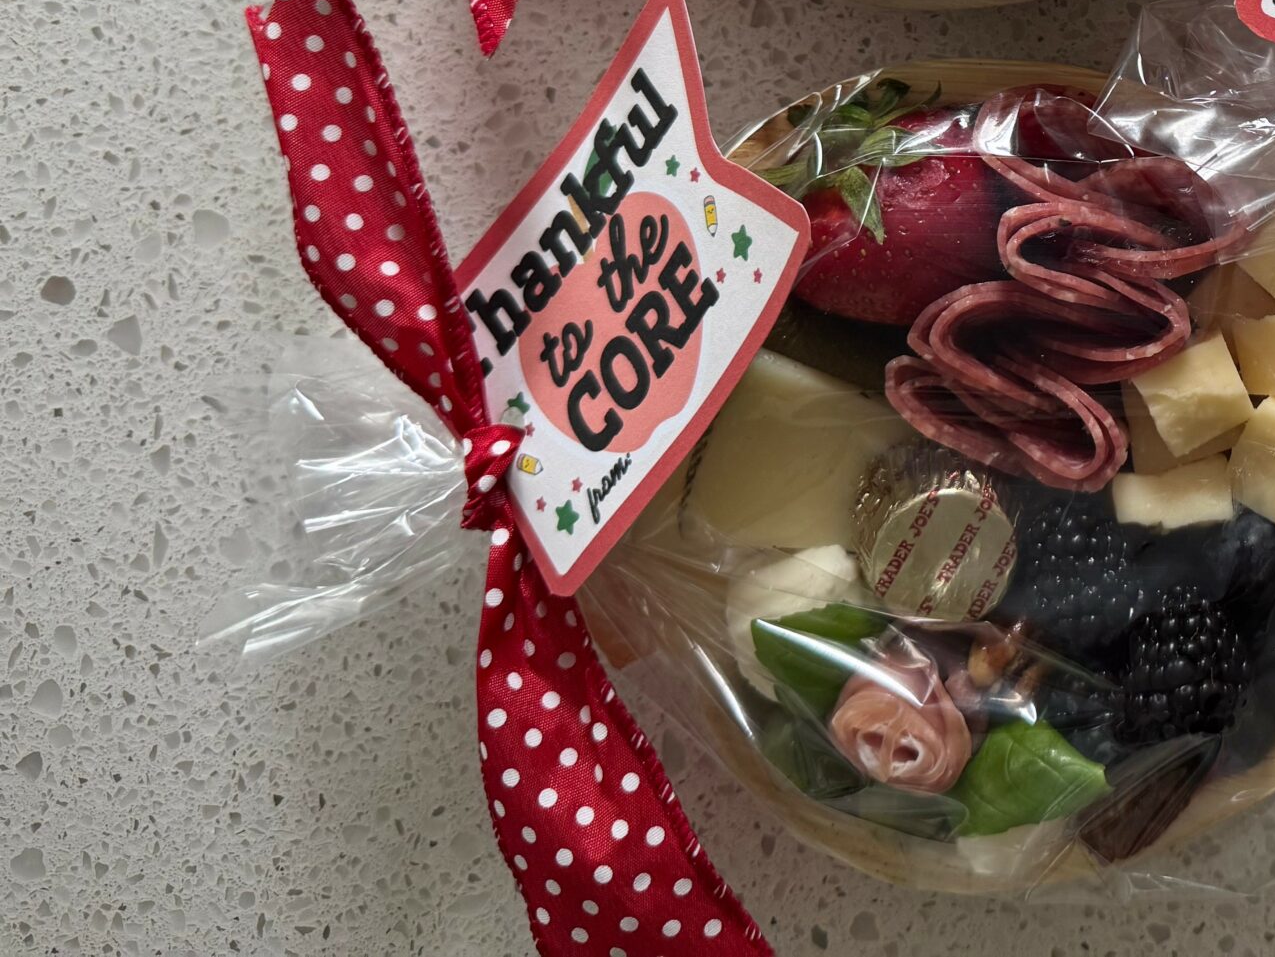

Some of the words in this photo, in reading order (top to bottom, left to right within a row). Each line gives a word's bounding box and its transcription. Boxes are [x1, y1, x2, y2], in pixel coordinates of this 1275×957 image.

[467, 67, 678, 378] hankful
[540, 317, 594, 390] to
[597, 212, 669, 313] the
[567, 241, 720, 452] CORE
[586, 451, 633, 524] from:
[936, 523, 980, 583] TRADER
